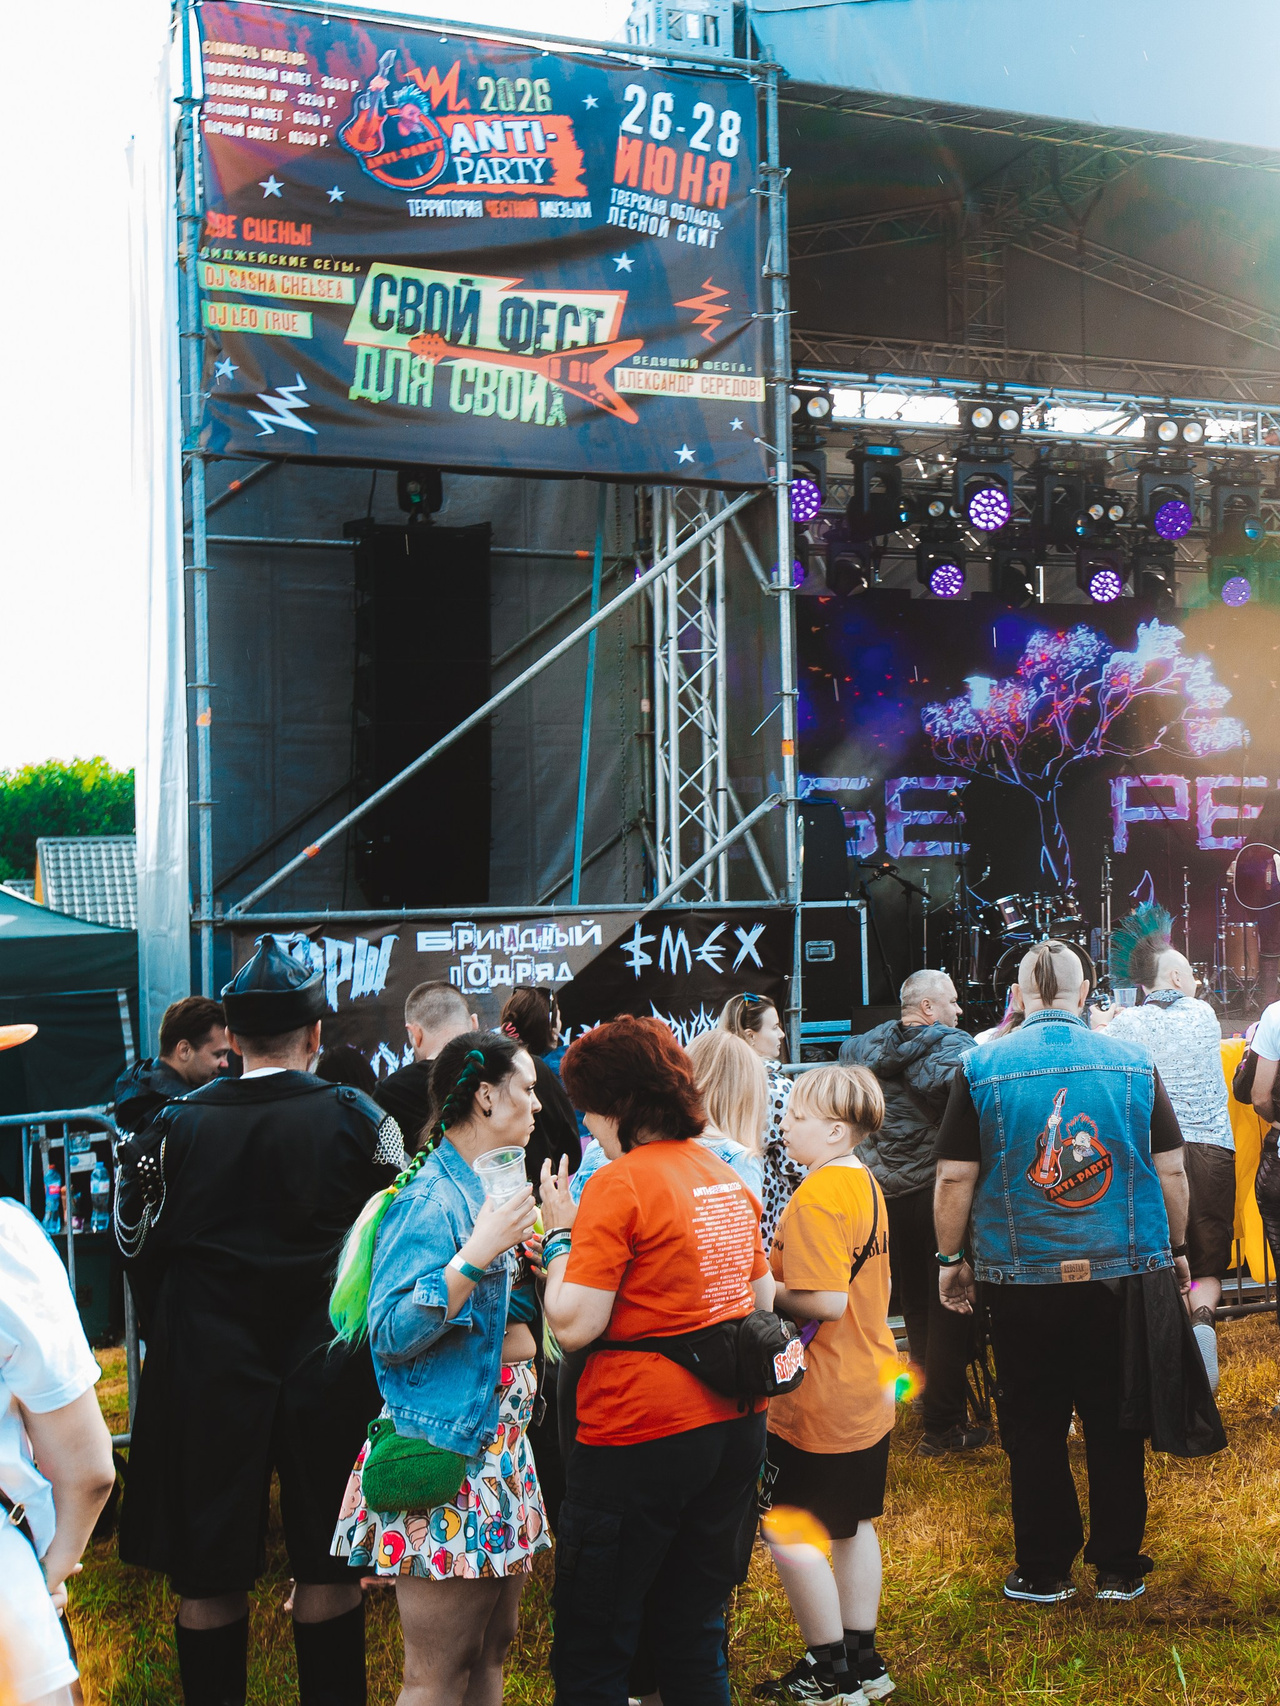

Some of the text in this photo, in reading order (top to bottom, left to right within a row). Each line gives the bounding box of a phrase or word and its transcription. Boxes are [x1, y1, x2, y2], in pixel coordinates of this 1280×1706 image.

[478, 76, 553, 112] 2026
[451, 120, 557, 154] ANTI-
[621, 83, 742, 158] 26-28
[452, 157, 546, 185] PARTY
[613, 135, 732, 210] ИЮНЯ
[406, 198, 593, 219] ТЕРРИТОРИЯ ЧЕСТНОЙ МУЗЫКИ
[610, 188, 725, 231] ТВЕРСКАЯ ОБЛАСТЬ,
[242, 216, 313, 247] СЦЕНЫ!
[605, 206, 719, 249] ЛЕСНОЙ СКИТ
[200, 246, 308, 269] ДИДЖЕЙСКИЕ
[204, 265, 344, 300] DJ SASHA CHELSEA
[208, 305, 300, 333] DJ LEO TRUE
[368, 272, 605, 356] СВОЙ ФЕСТ
[632, 355, 699, 370] ВЕДУЩИЙ
[348, 344, 568, 428] ДЛЯ СВОИХ
[618, 370, 762, 398] АЛЕКСАНДР СЕРЕДОВ!
[417, 920, 603, 953] БРИГАДНЫЙ
[450, 957, 575, 993] ПОДРЯД
[1049, 1154, 1112, 1200] ANTI-PARTY
